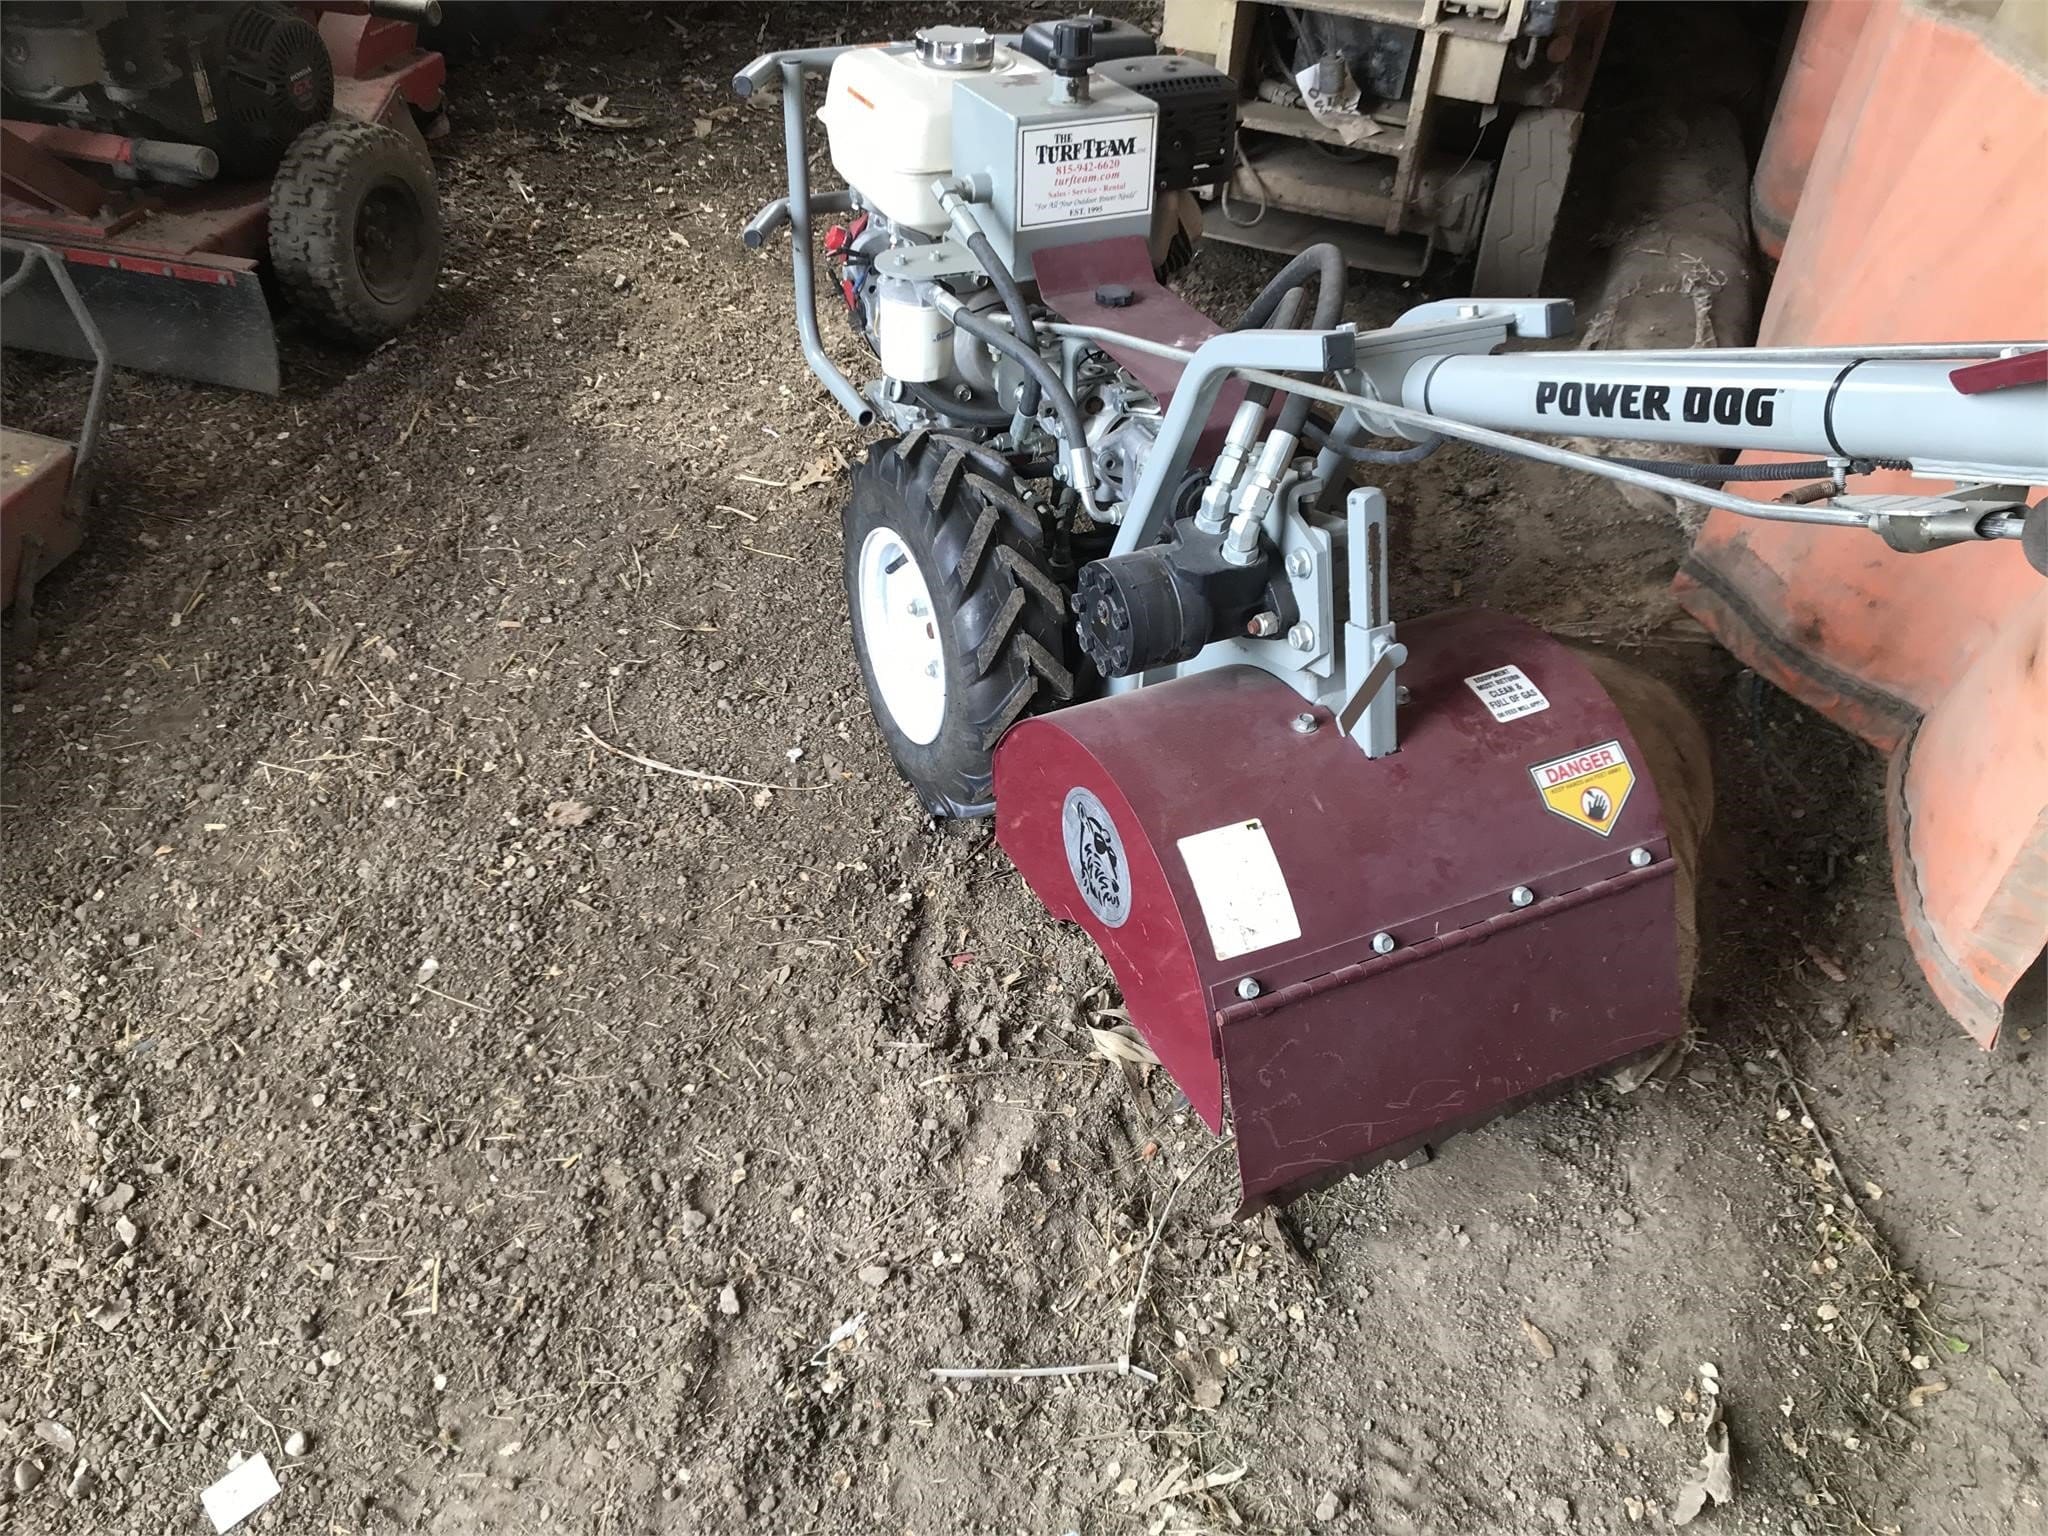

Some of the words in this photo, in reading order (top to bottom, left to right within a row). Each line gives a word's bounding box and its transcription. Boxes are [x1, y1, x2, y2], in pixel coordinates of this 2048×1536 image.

[1055, 133, 1072, 144] THE
[1056, 160, 1120, 175] 815-942-6620
[1054, 172, 1120, 187] turfteam.com
[1048, 189, 1066, 198] Sales
[1072, 187, 1097, 196] Service
[1103, 182, 1126, 192] Rental
[1087, 206, 1103, 214] 1995
[1536, 381, 1671, 421] POWER
[1683, 386, 1777, 427] DOG
[1473, 669, 1510, 683] EQUIPMENT
[1476, 681, 1495, 691] MUST
[1495, 674, 1520, 685] RETURN
[1489, 684, 1516, 698] CLEAN
[1488, 697, 1510, 709] FULL
[1509, 694, 1520, 703] OF
[1520, 689, 1538, 699] GAS
[1545, 750, 1614, 784] DANGER
